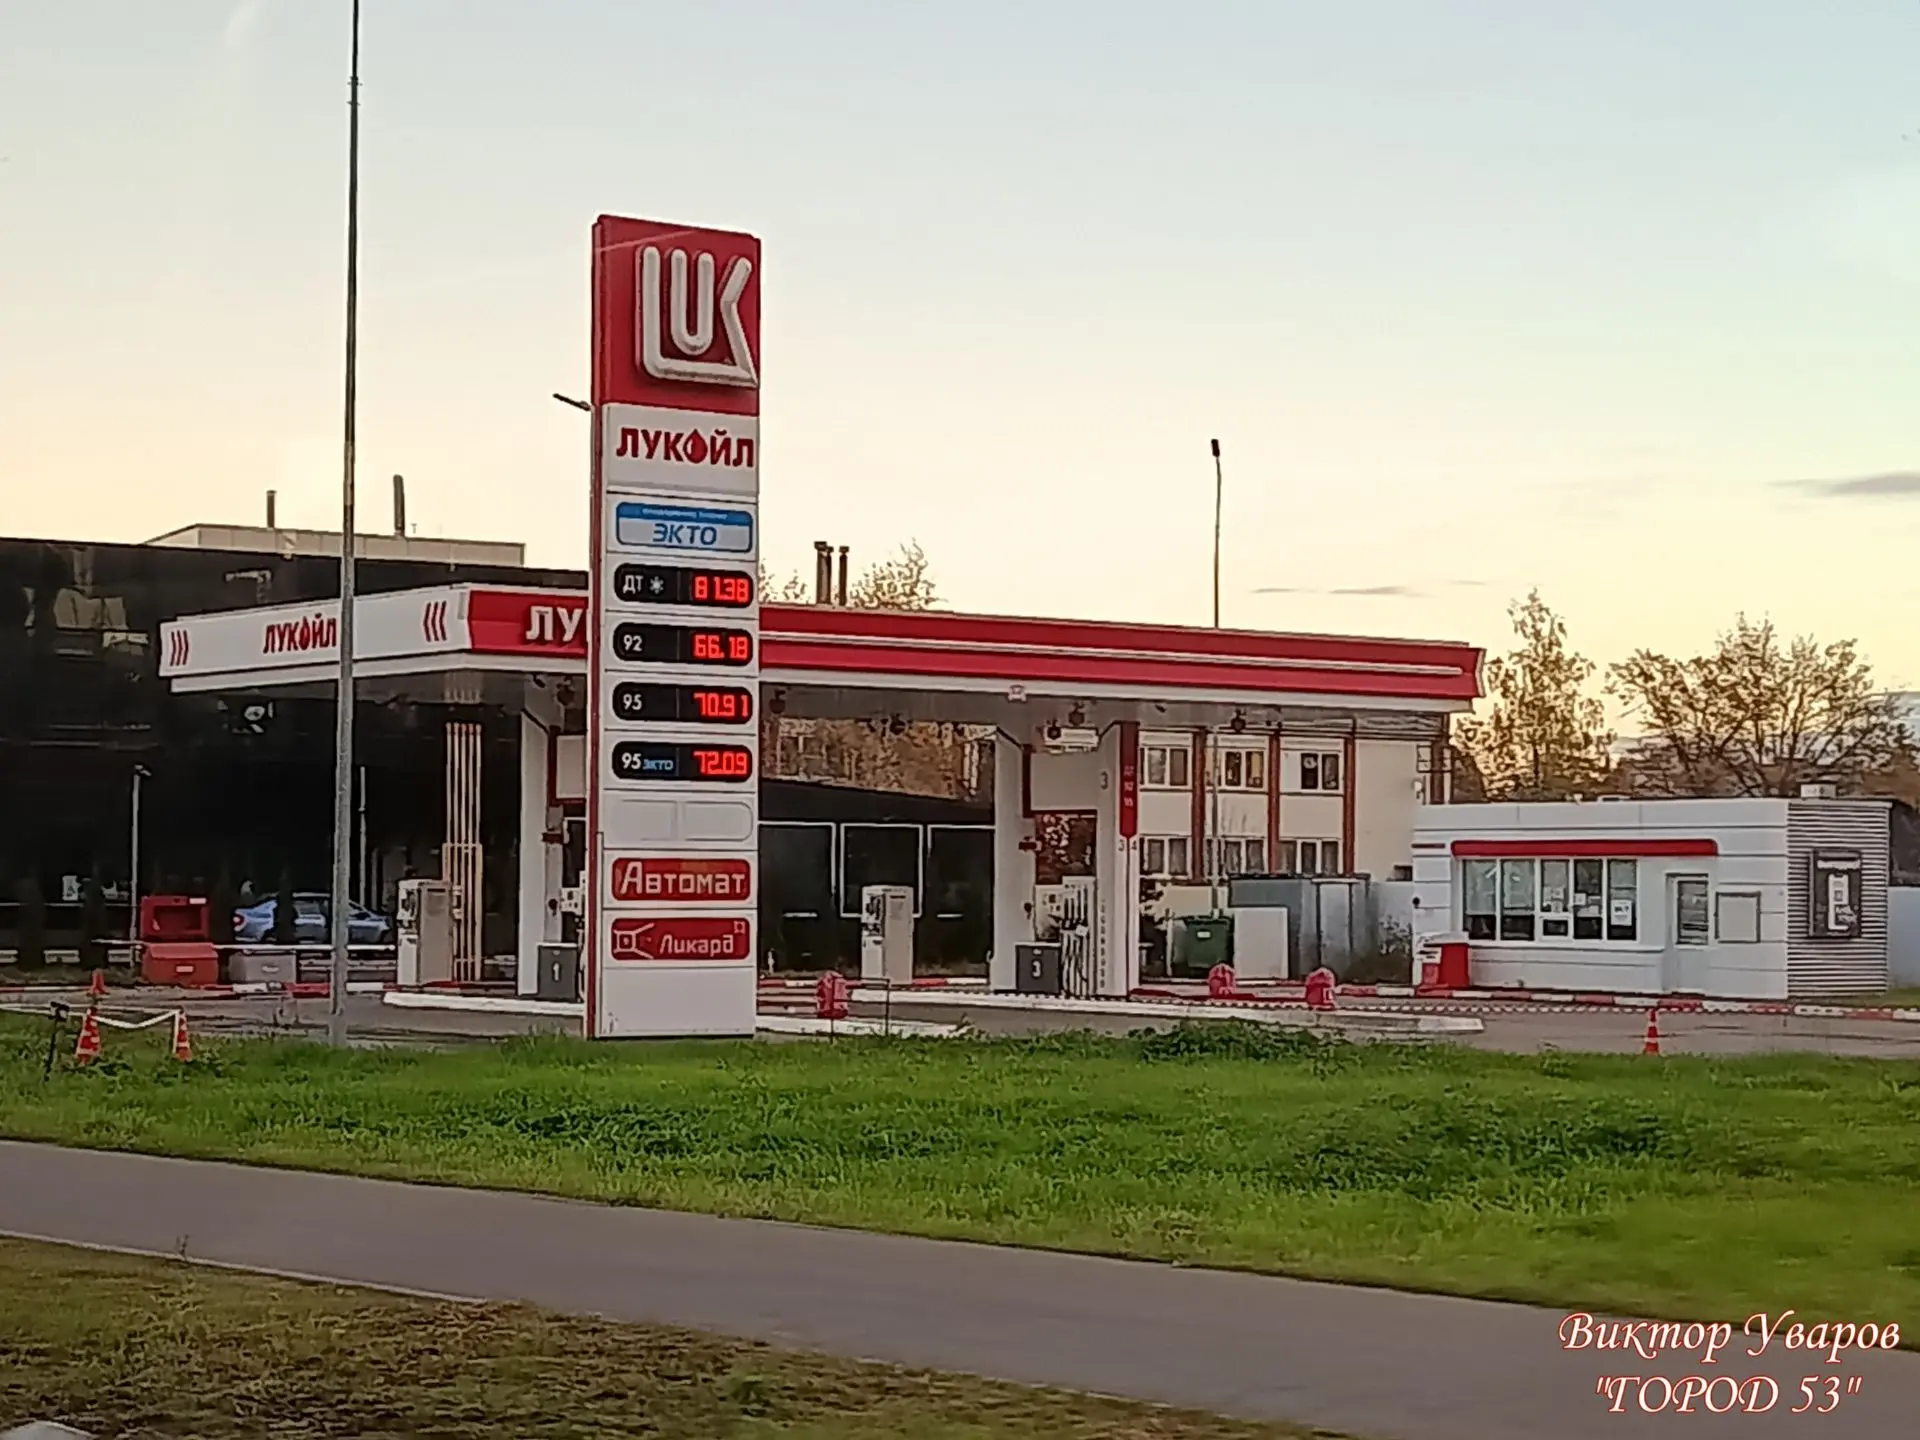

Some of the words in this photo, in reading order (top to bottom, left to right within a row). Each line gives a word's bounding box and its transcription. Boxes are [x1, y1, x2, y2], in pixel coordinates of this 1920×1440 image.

[616, 427, 754, 468] ЛУКОЙЛ
[652, 523, 717, 545] ЭКТО
[622, 575, 645, 594] ДТ
[263, 612, 337, 654] ЛУКОЙЛ
[623, 634, 643, 652] 92
[622, 693, 643, 711] 95
[621, 752, 642, 770] 95
[620, 861, 746, 895] Автомат
[659, 934, 734, 957] Ликард
